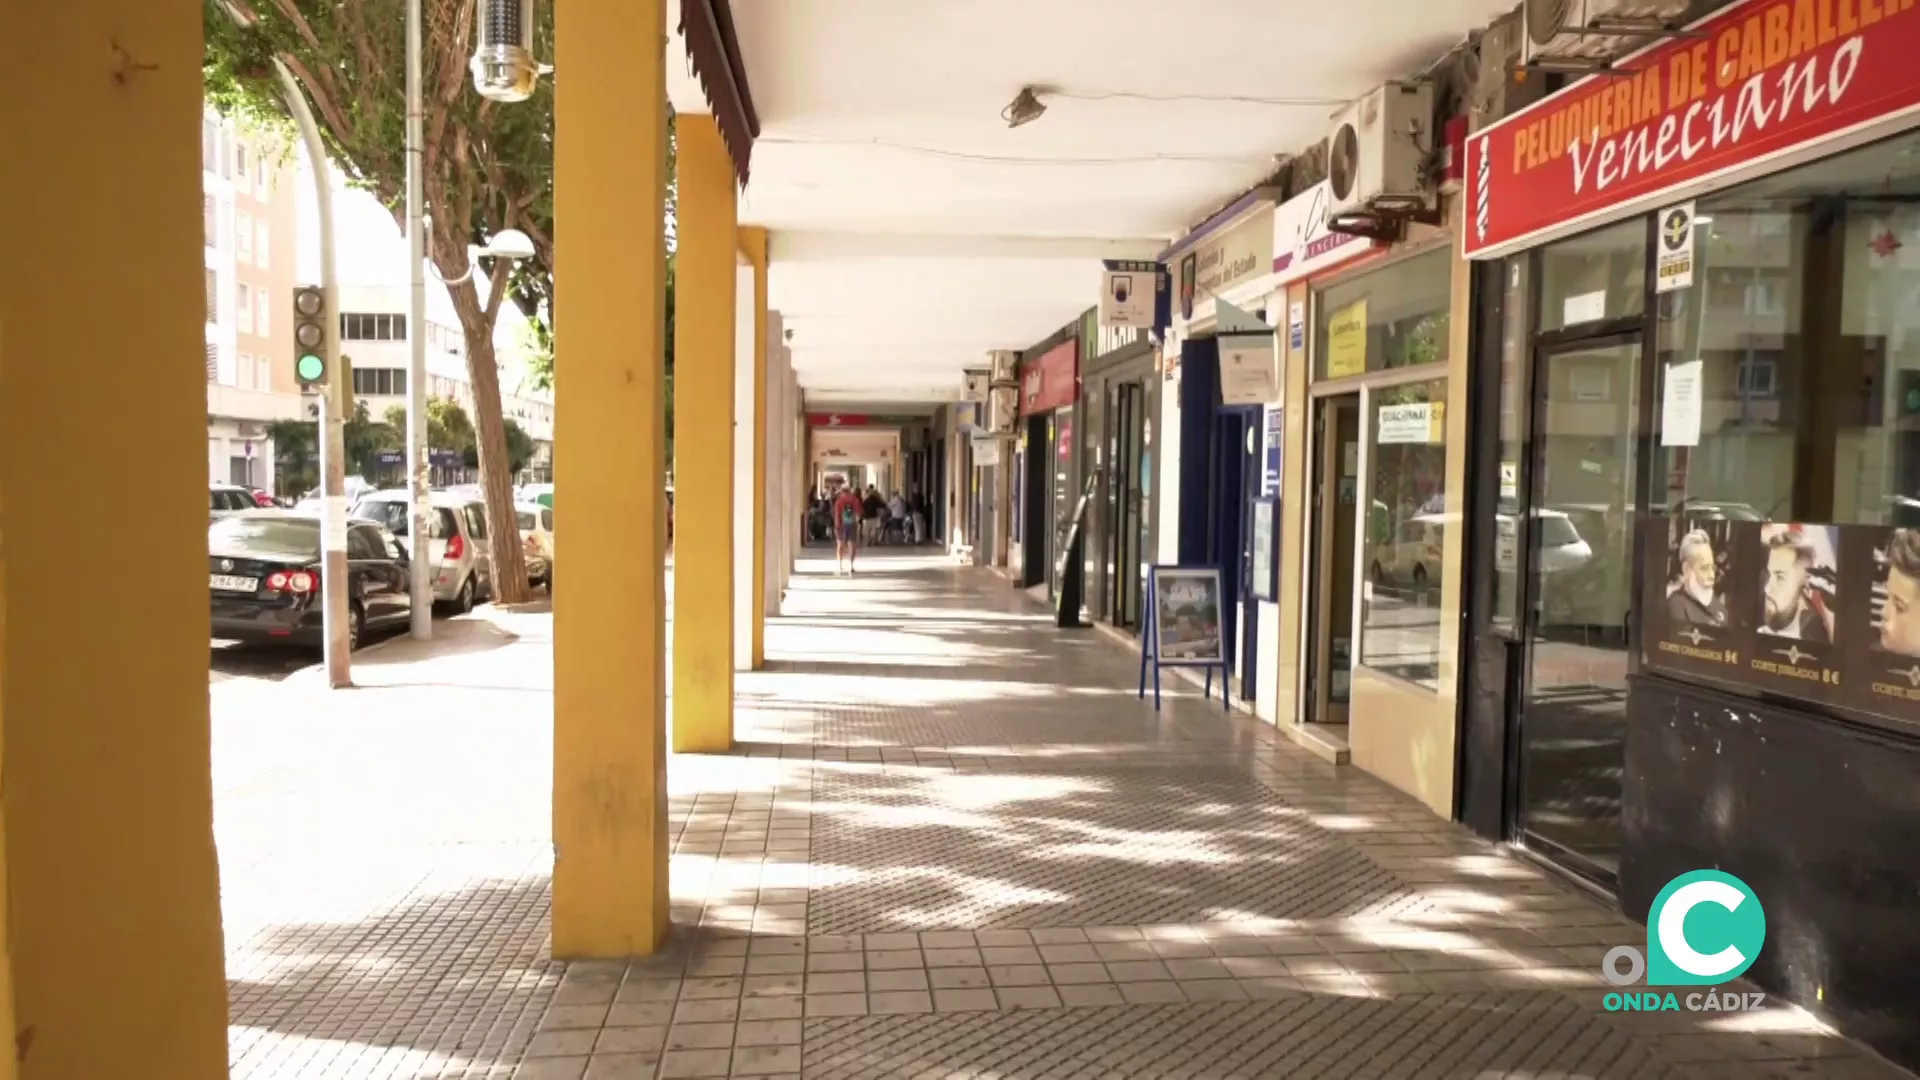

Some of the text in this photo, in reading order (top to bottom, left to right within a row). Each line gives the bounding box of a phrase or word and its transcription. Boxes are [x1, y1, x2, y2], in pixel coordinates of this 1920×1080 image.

[1513, 0, 1914, 174] PELUQUERIA DE CABALL
[1567, 35, 1863, 195] Veneciano
